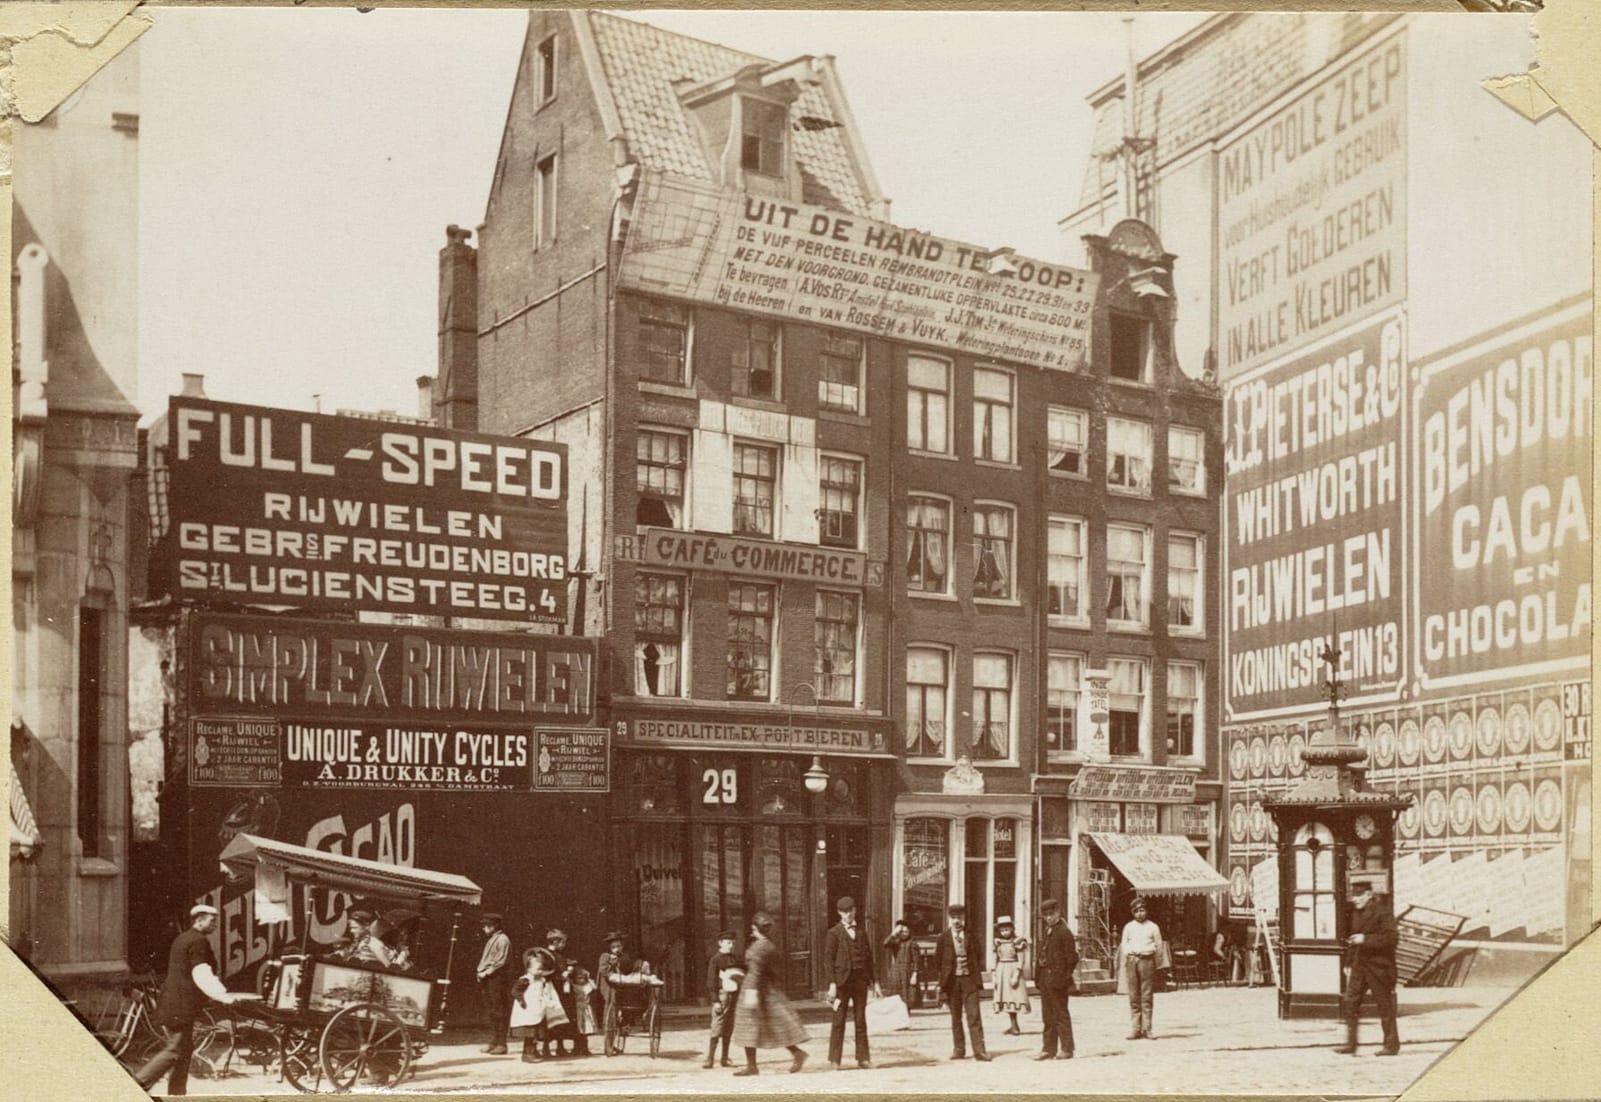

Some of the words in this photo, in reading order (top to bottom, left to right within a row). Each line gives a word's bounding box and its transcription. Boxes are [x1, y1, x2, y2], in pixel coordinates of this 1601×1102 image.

[1223, 92, 1326, 204] MAYPOLE
[1333, 42, 1401, 136] ZEEP
[737, 225, 756, 243] DE
[763, 230, 792, 249] VIJF
[795, 237, 877, 268] PERCEELEN
[744, 198, 799, 228] UIT
[809, 213, 854, 242] DE
[863, 226, 944, 262] HAND
[726, 262, 738, 280] Te
[739, 264, 788, 293] bevragen
[733, 246, 764, 262] MET
[766, 252, 795, 270] DEN
[956, 293, 1028, 319] OPPERVLAKTE
[1047, 312, 1072, 328] 800
[1227, 244, 1280, 306] VERFT
[732, 288, 746, 303] de
[746, 289, 786, 310] Heeren
[819, 306, 843, 322] VAN
[845, 306, 897, 331] ROSSEM
[1227, 322, 1242, 368] IN
[1246, 301, 1288, 357] ALLE
[1294, 249, 1392, 337] KLEUREN
[177, 408, 562, 500] FULL-SPEED
[264, 492, 503, 540] RIJWIELEN
[1236, 441, 1396, 545] WHITWORTH
[323, 536, 565, 580] FREUDENBORG
[1232, 528, 1391, 632] RIJWIELEN
[1513, 560, 1560, 585] EN
[200, 628, 389, 708] SIMPLEX
[1375, 622, 1398, 676] 13
[236, 722, 277, 737] UNIQUE
[287, 724, 362, 766] UNIQUE
[366, 737, 381, 764] &
[385, 728, 447, 765] UNITY
[454, 731, 528, 768] CYCLES
[572, 733, 606, 747] UNIQUE
[638, 723, 734, 740] SPECIALITEIT
[345, 765, 460, 783] DRUKKER
[464, 770, 478, 783] &
[702, 768, 738, 804] 29
